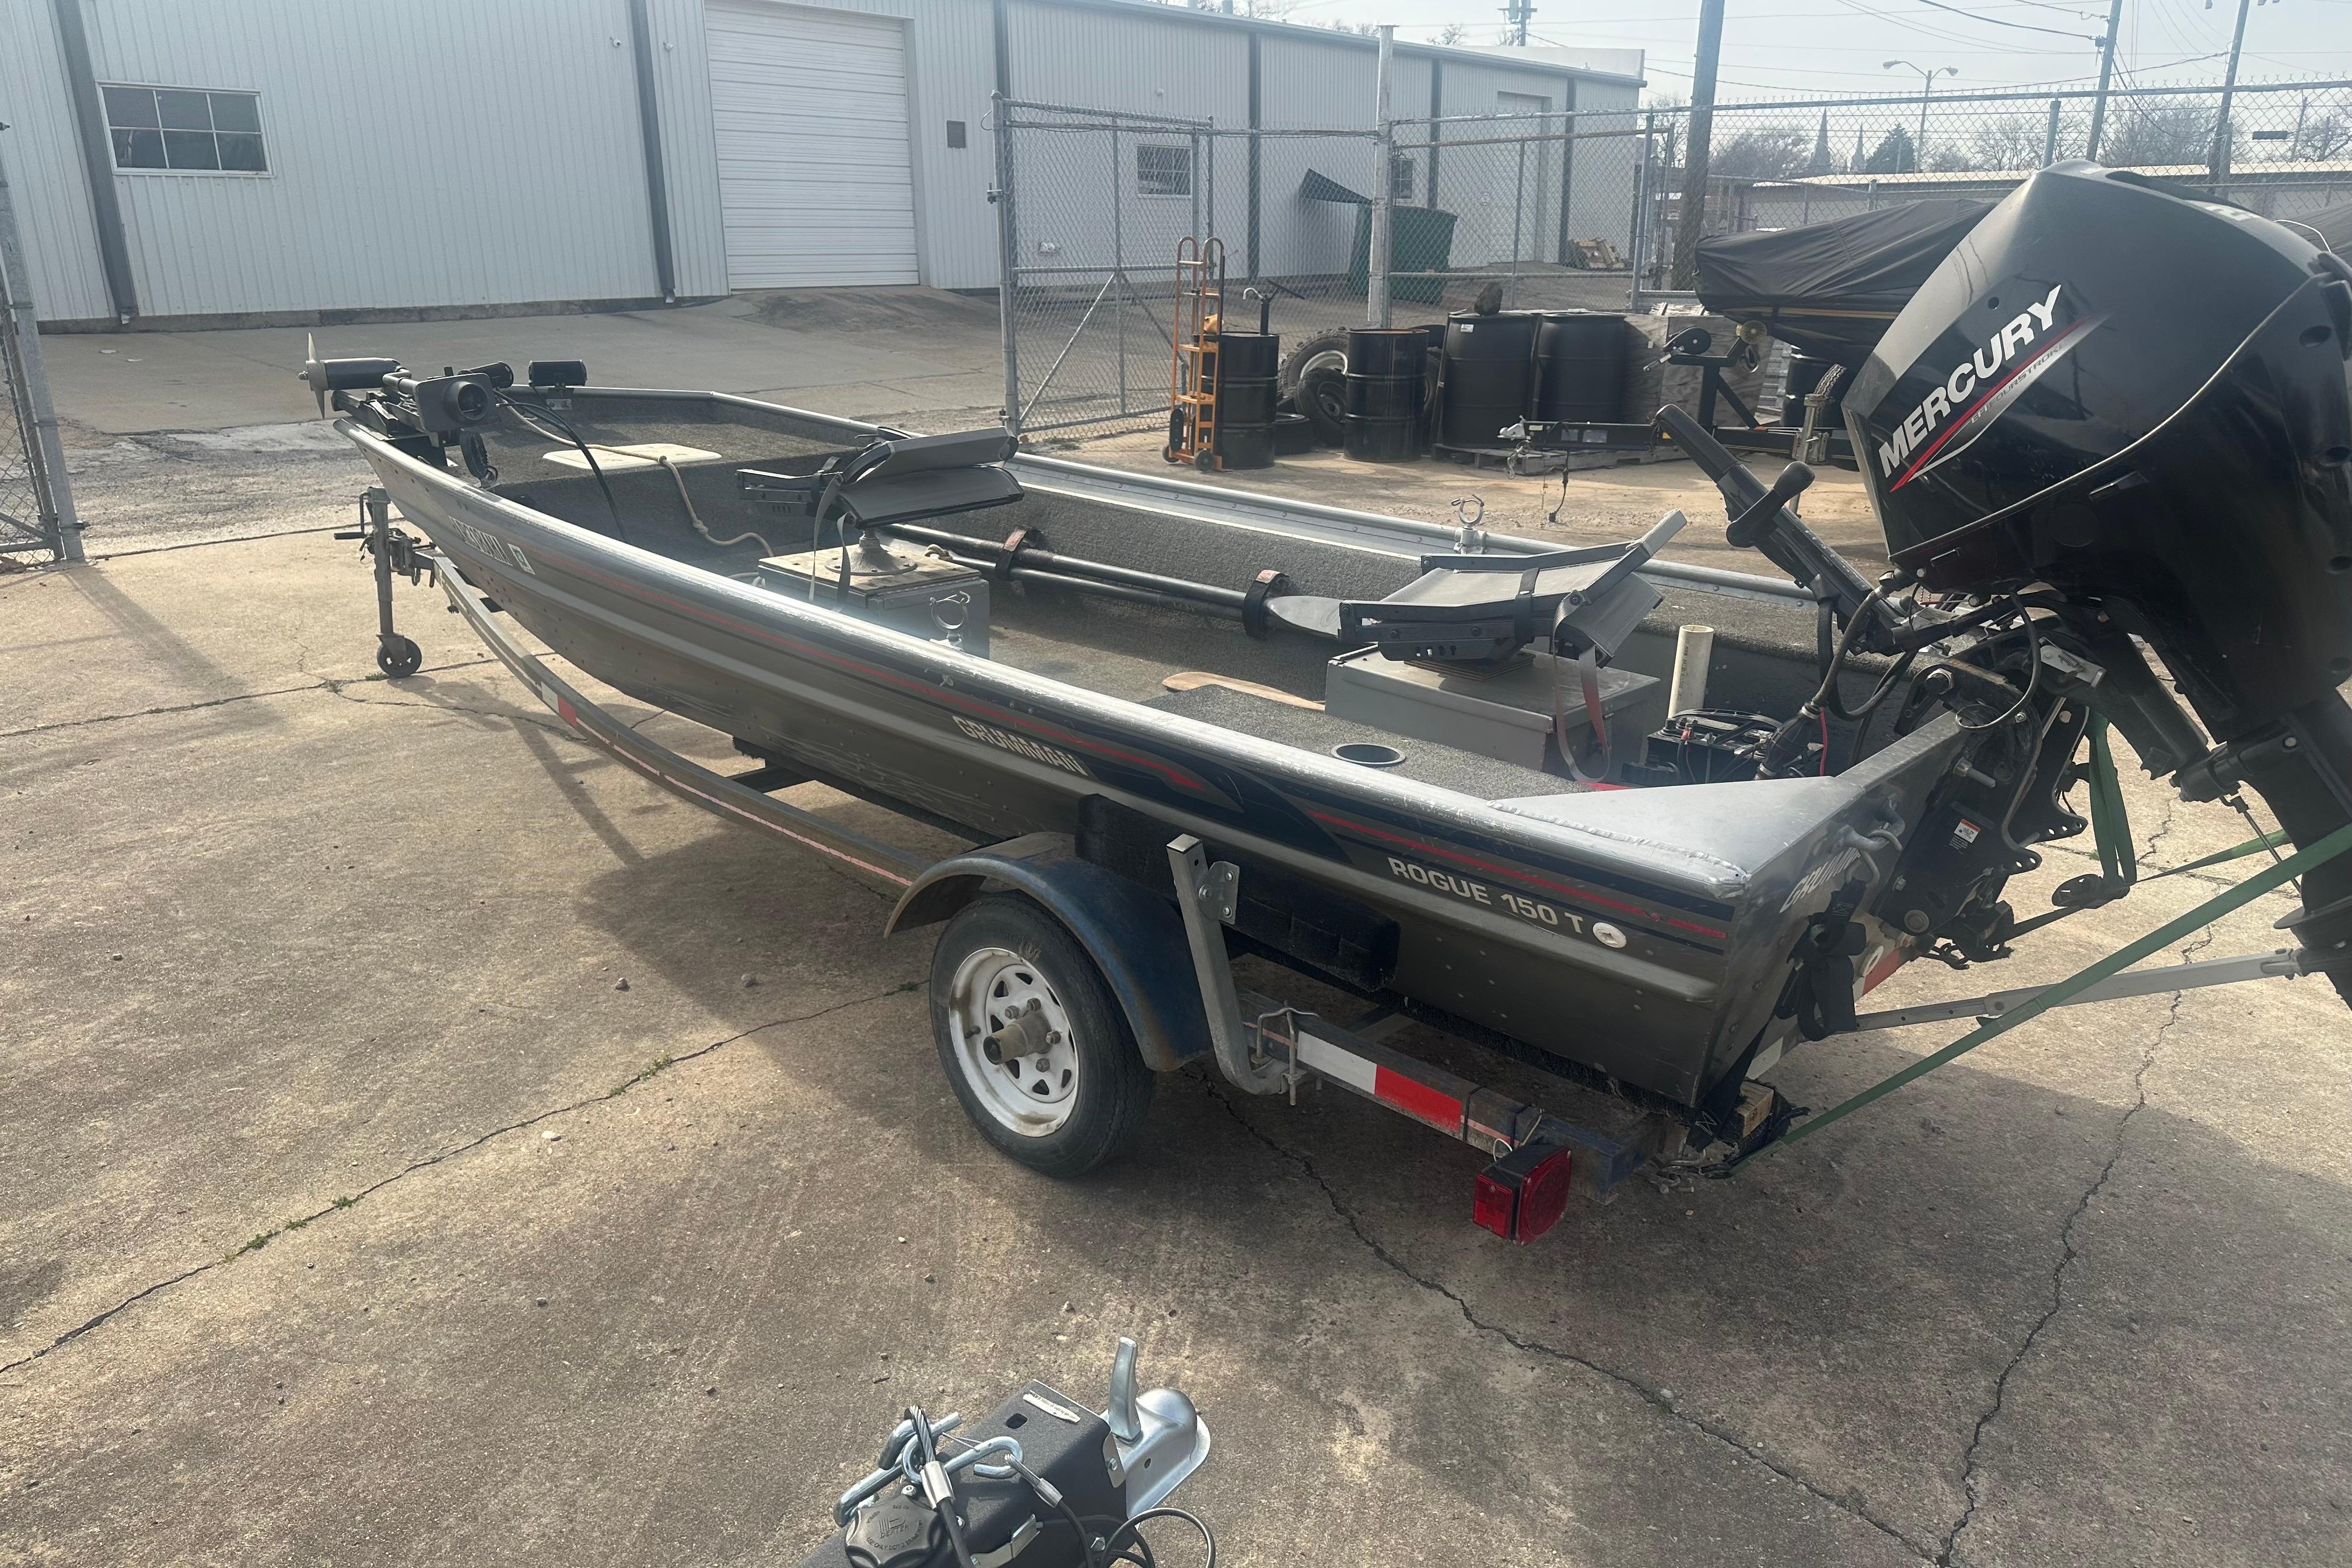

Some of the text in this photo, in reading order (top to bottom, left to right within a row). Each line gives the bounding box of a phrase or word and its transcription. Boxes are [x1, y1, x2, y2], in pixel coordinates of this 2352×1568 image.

[1878, 285, 2062, 477] MERCURY
[1971, 404, 1988, 424] EFI
[952, 716, 1088, 776] GRUMMAN
[1388, 857, 1583, 934] ROGUE 150 T
